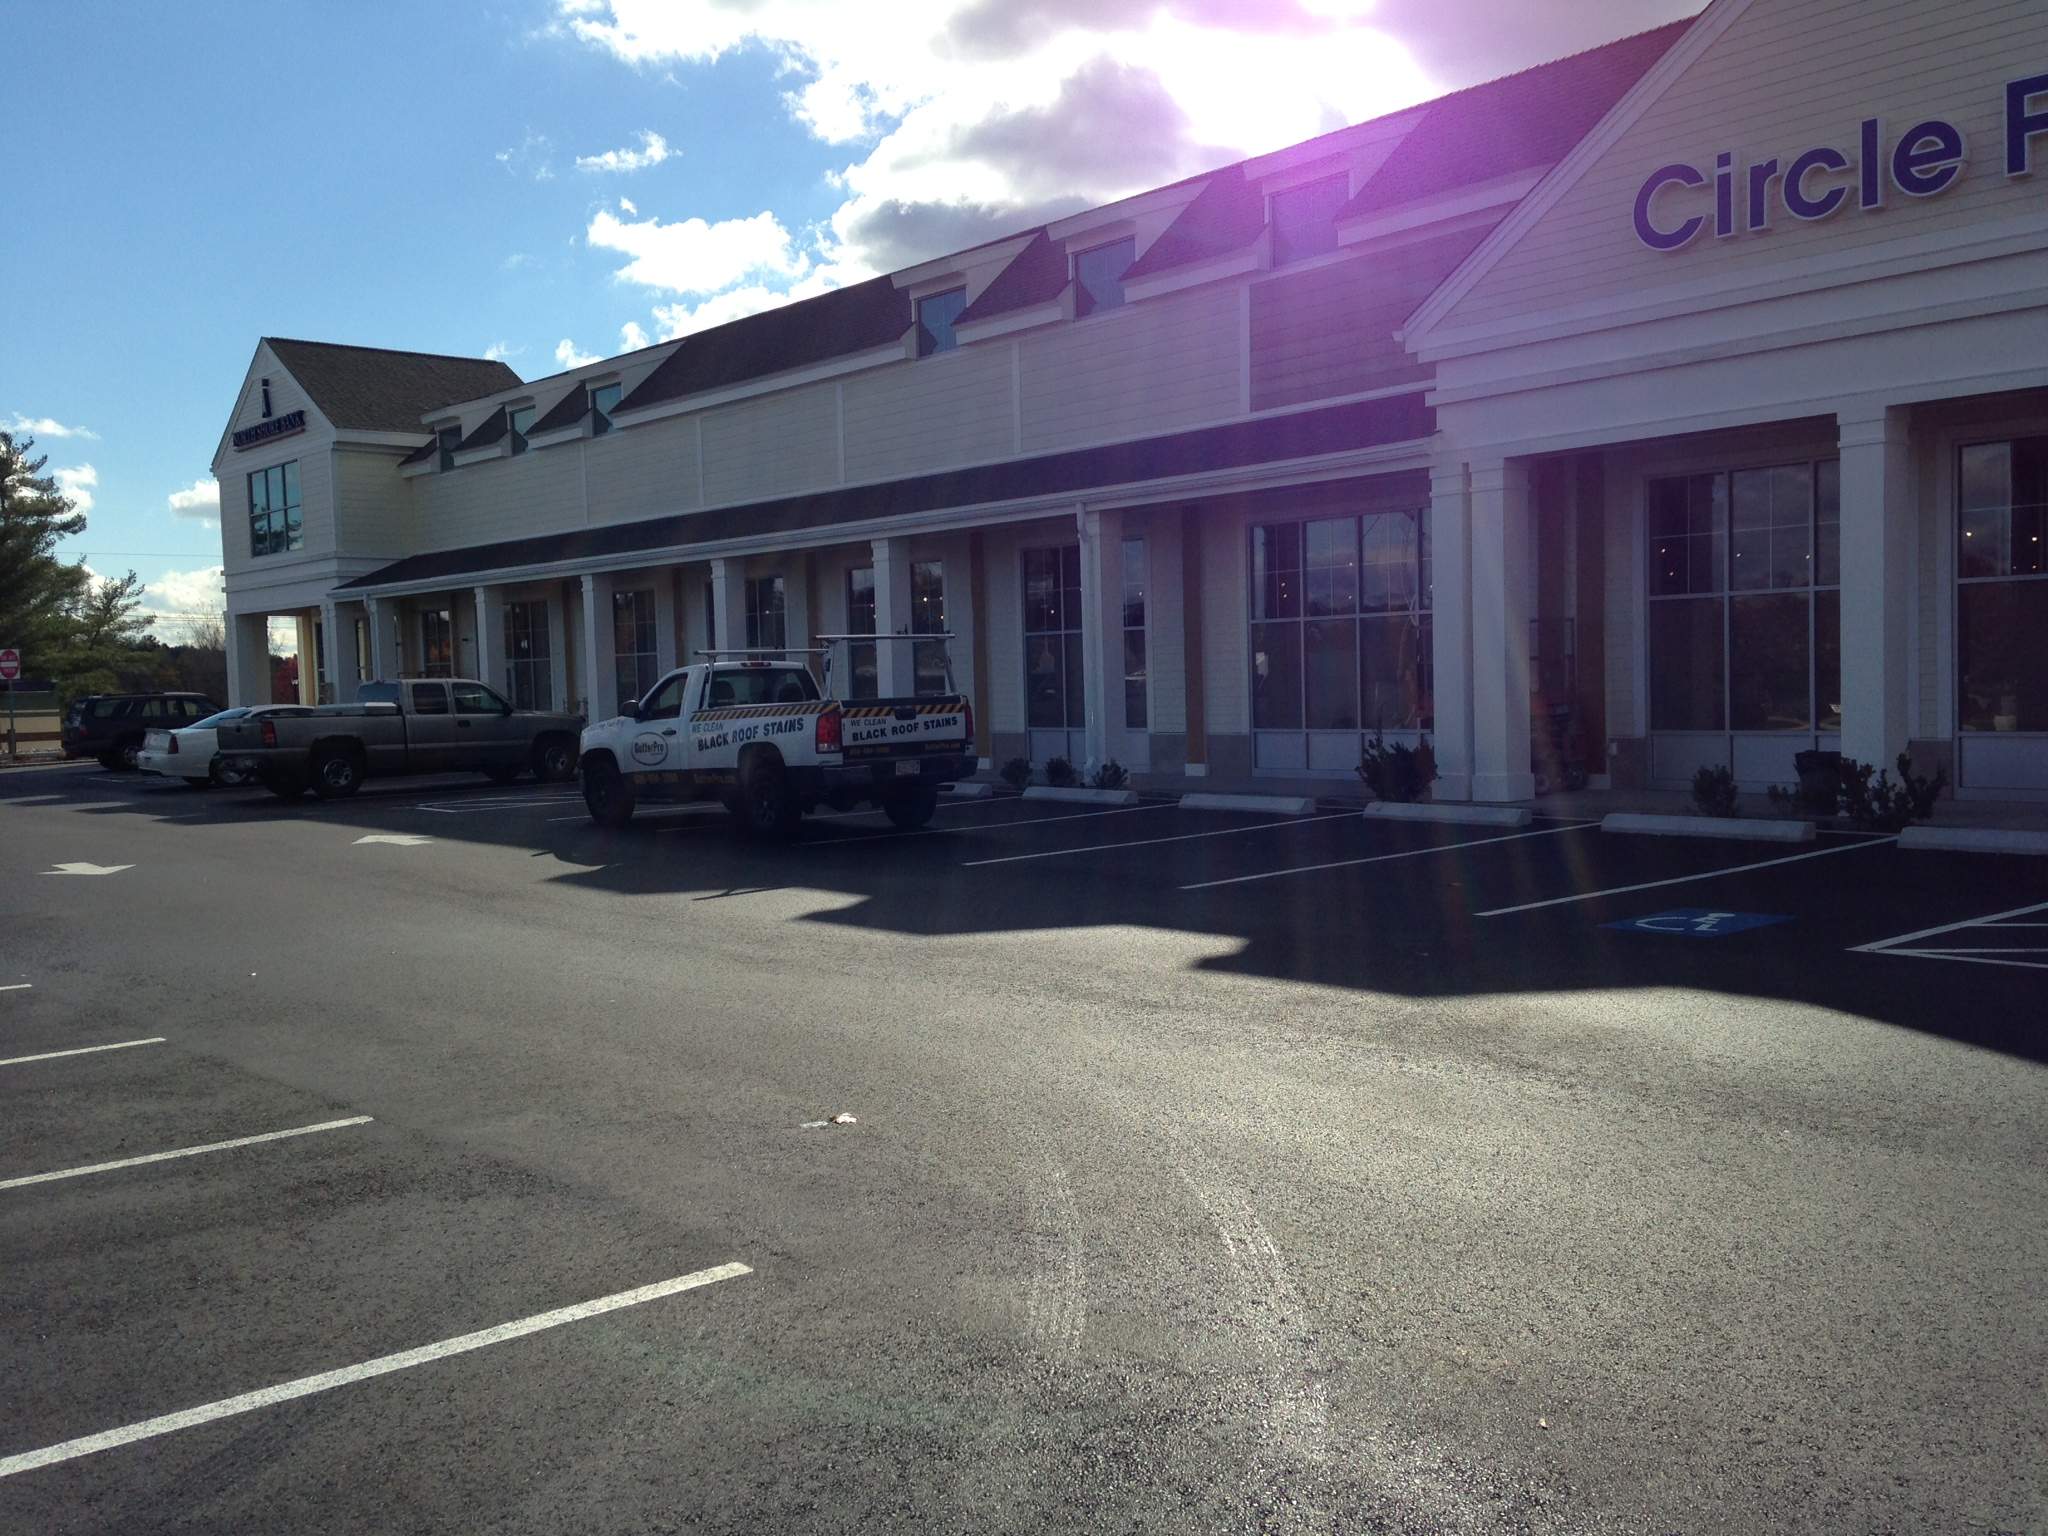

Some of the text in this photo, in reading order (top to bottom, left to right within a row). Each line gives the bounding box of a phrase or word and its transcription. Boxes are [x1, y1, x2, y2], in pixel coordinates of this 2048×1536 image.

[1633, 118, 1967, 252] Circle
[697, 717, 804, 751] BLACK ROOF STAINS
[703, 721, 724, 732] CLEAN
[852, 716, 958, 742] BLACK ROOF STAINS
[864, 718, 887, 726] CLEAN
